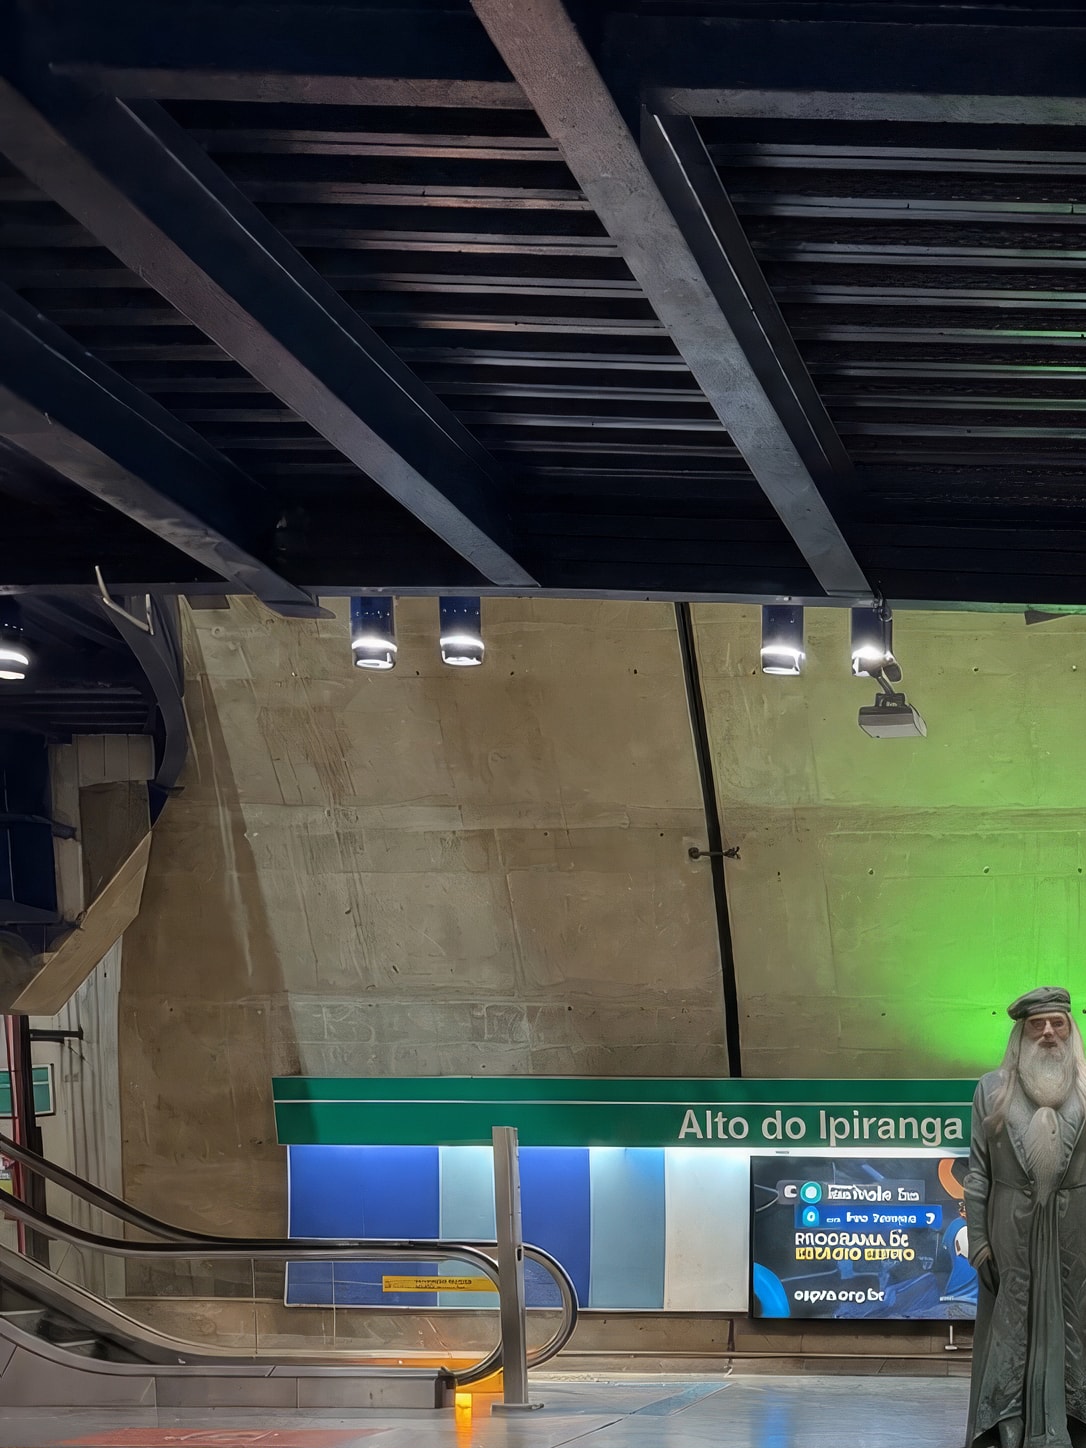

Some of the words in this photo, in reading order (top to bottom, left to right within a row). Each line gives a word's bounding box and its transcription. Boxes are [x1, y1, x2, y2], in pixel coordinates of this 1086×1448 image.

[678, 1109, 749, 1139] Alto
[761, 1109, 807, 1140] do
[818, 1109, 964, 1147] Ipiranga
